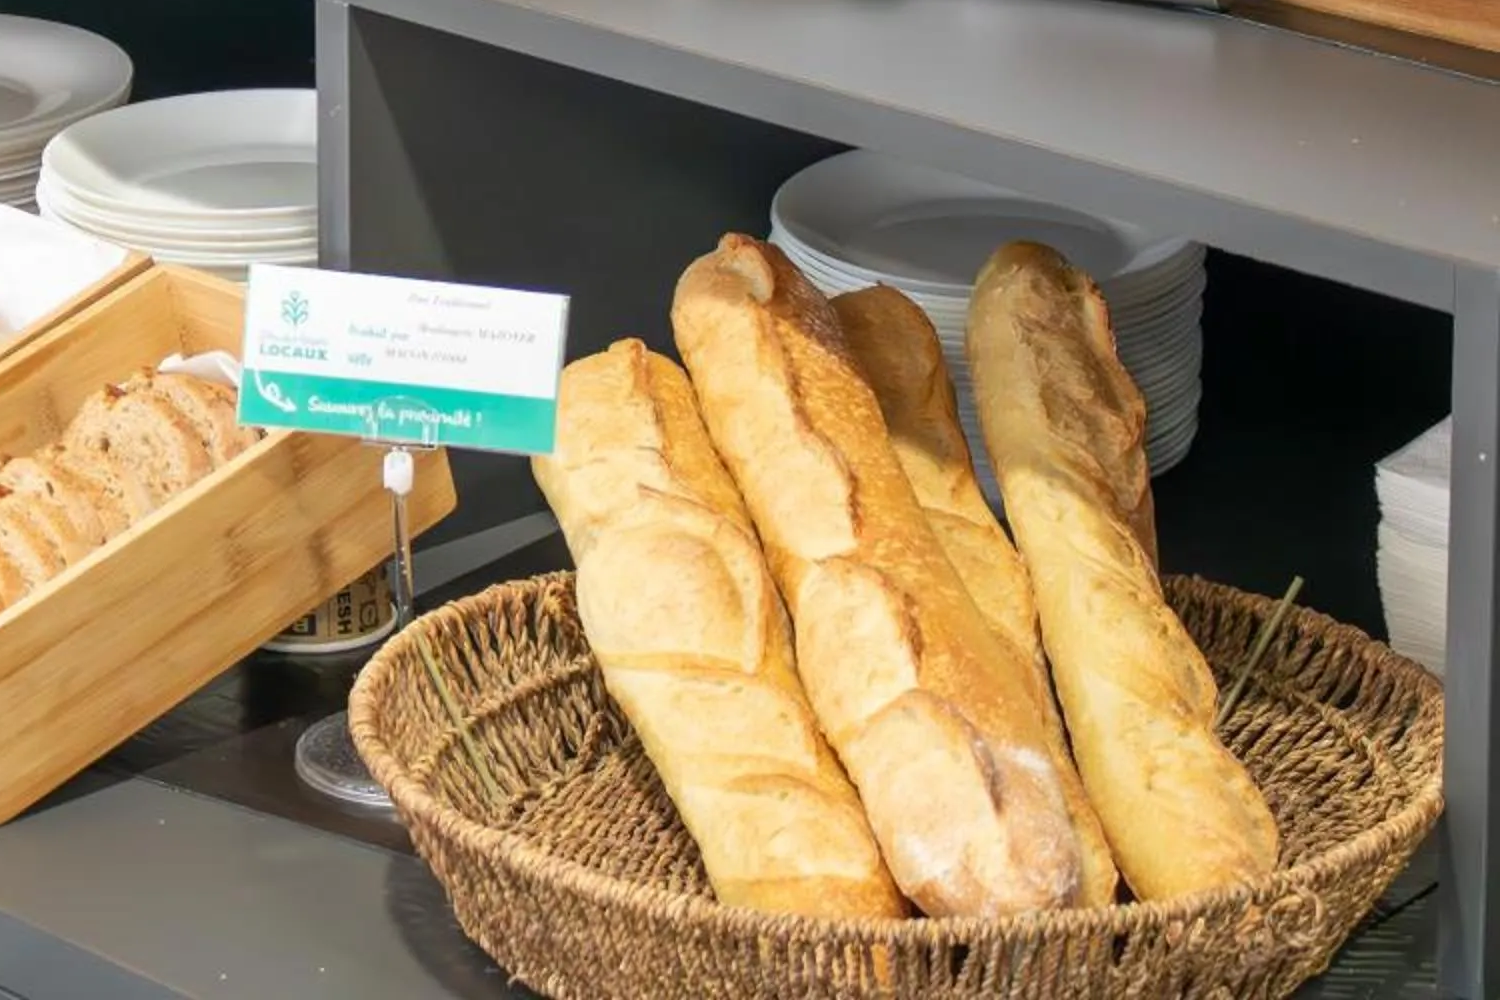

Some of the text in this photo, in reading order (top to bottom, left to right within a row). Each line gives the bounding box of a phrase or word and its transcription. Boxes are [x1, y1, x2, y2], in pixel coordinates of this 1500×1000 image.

[258, 343, 329, 361] LOCAUX
[307, 395, 374, 422] Savourez
[376, 400, 396, 420] la
[398, 406, 472, 428] proximité
[337, 587, 351, 634] ESH
